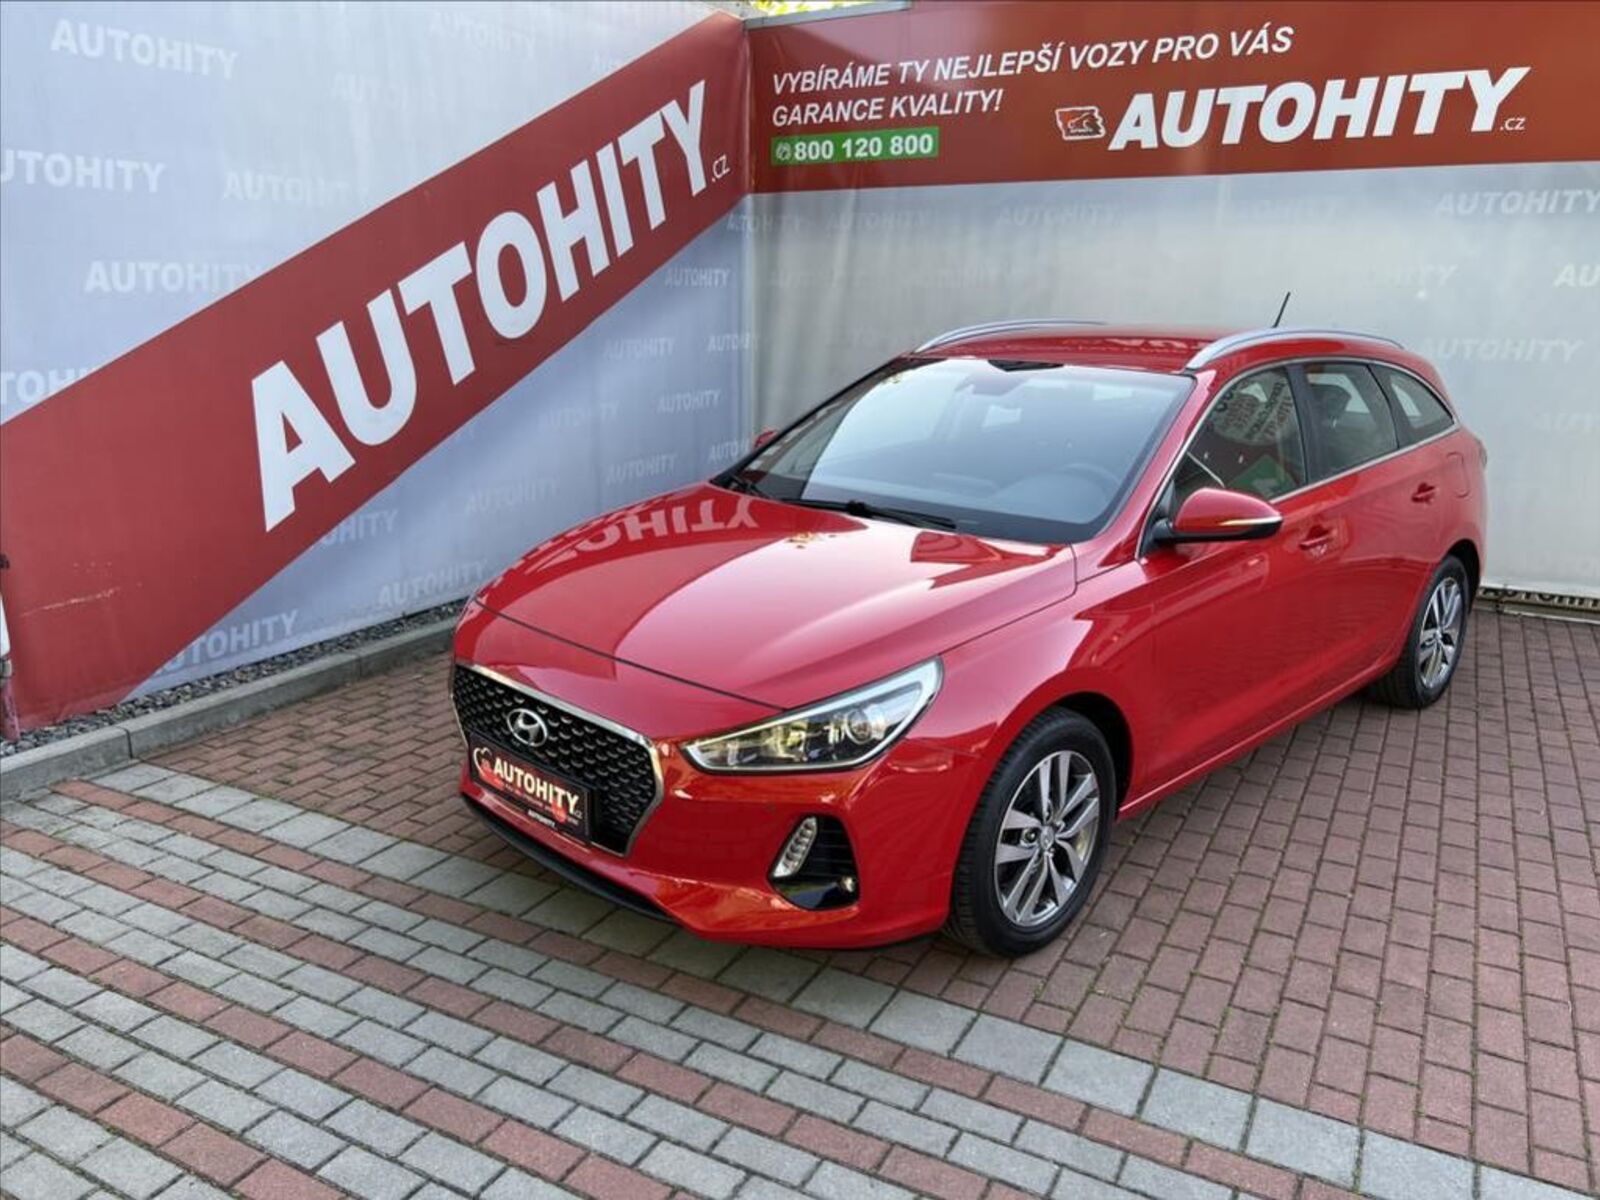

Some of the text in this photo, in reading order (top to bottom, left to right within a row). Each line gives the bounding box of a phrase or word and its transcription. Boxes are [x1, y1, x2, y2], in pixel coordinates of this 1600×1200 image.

[50, 19, 239, 80] AUTOHITY
[773, 22, 1295, 95] VYBÍRÁME TY NEJLEPŠÍ VOZY PRO VÁS
[772, 88, 1003, 127] GARANCE KVALITY!
[794, 133, 934, 161] 800 120 800
[0, 149, 166, 193] UTOHITY
[1435, 189, 1600, 215] AUTOHITY
[664, 267, 731, 289] AUTOHITY
[1554, 263, 1600, 288] AU
[602, 337, 676, 360] AUTOHITY
[656, 389, 721, 415] AUTOHITY
[606, 453, 679, 486] AUTOHITY
[378, 558, 488, 608] AUTOHITY
[493, 757, 579, 815] AUTOHITY
